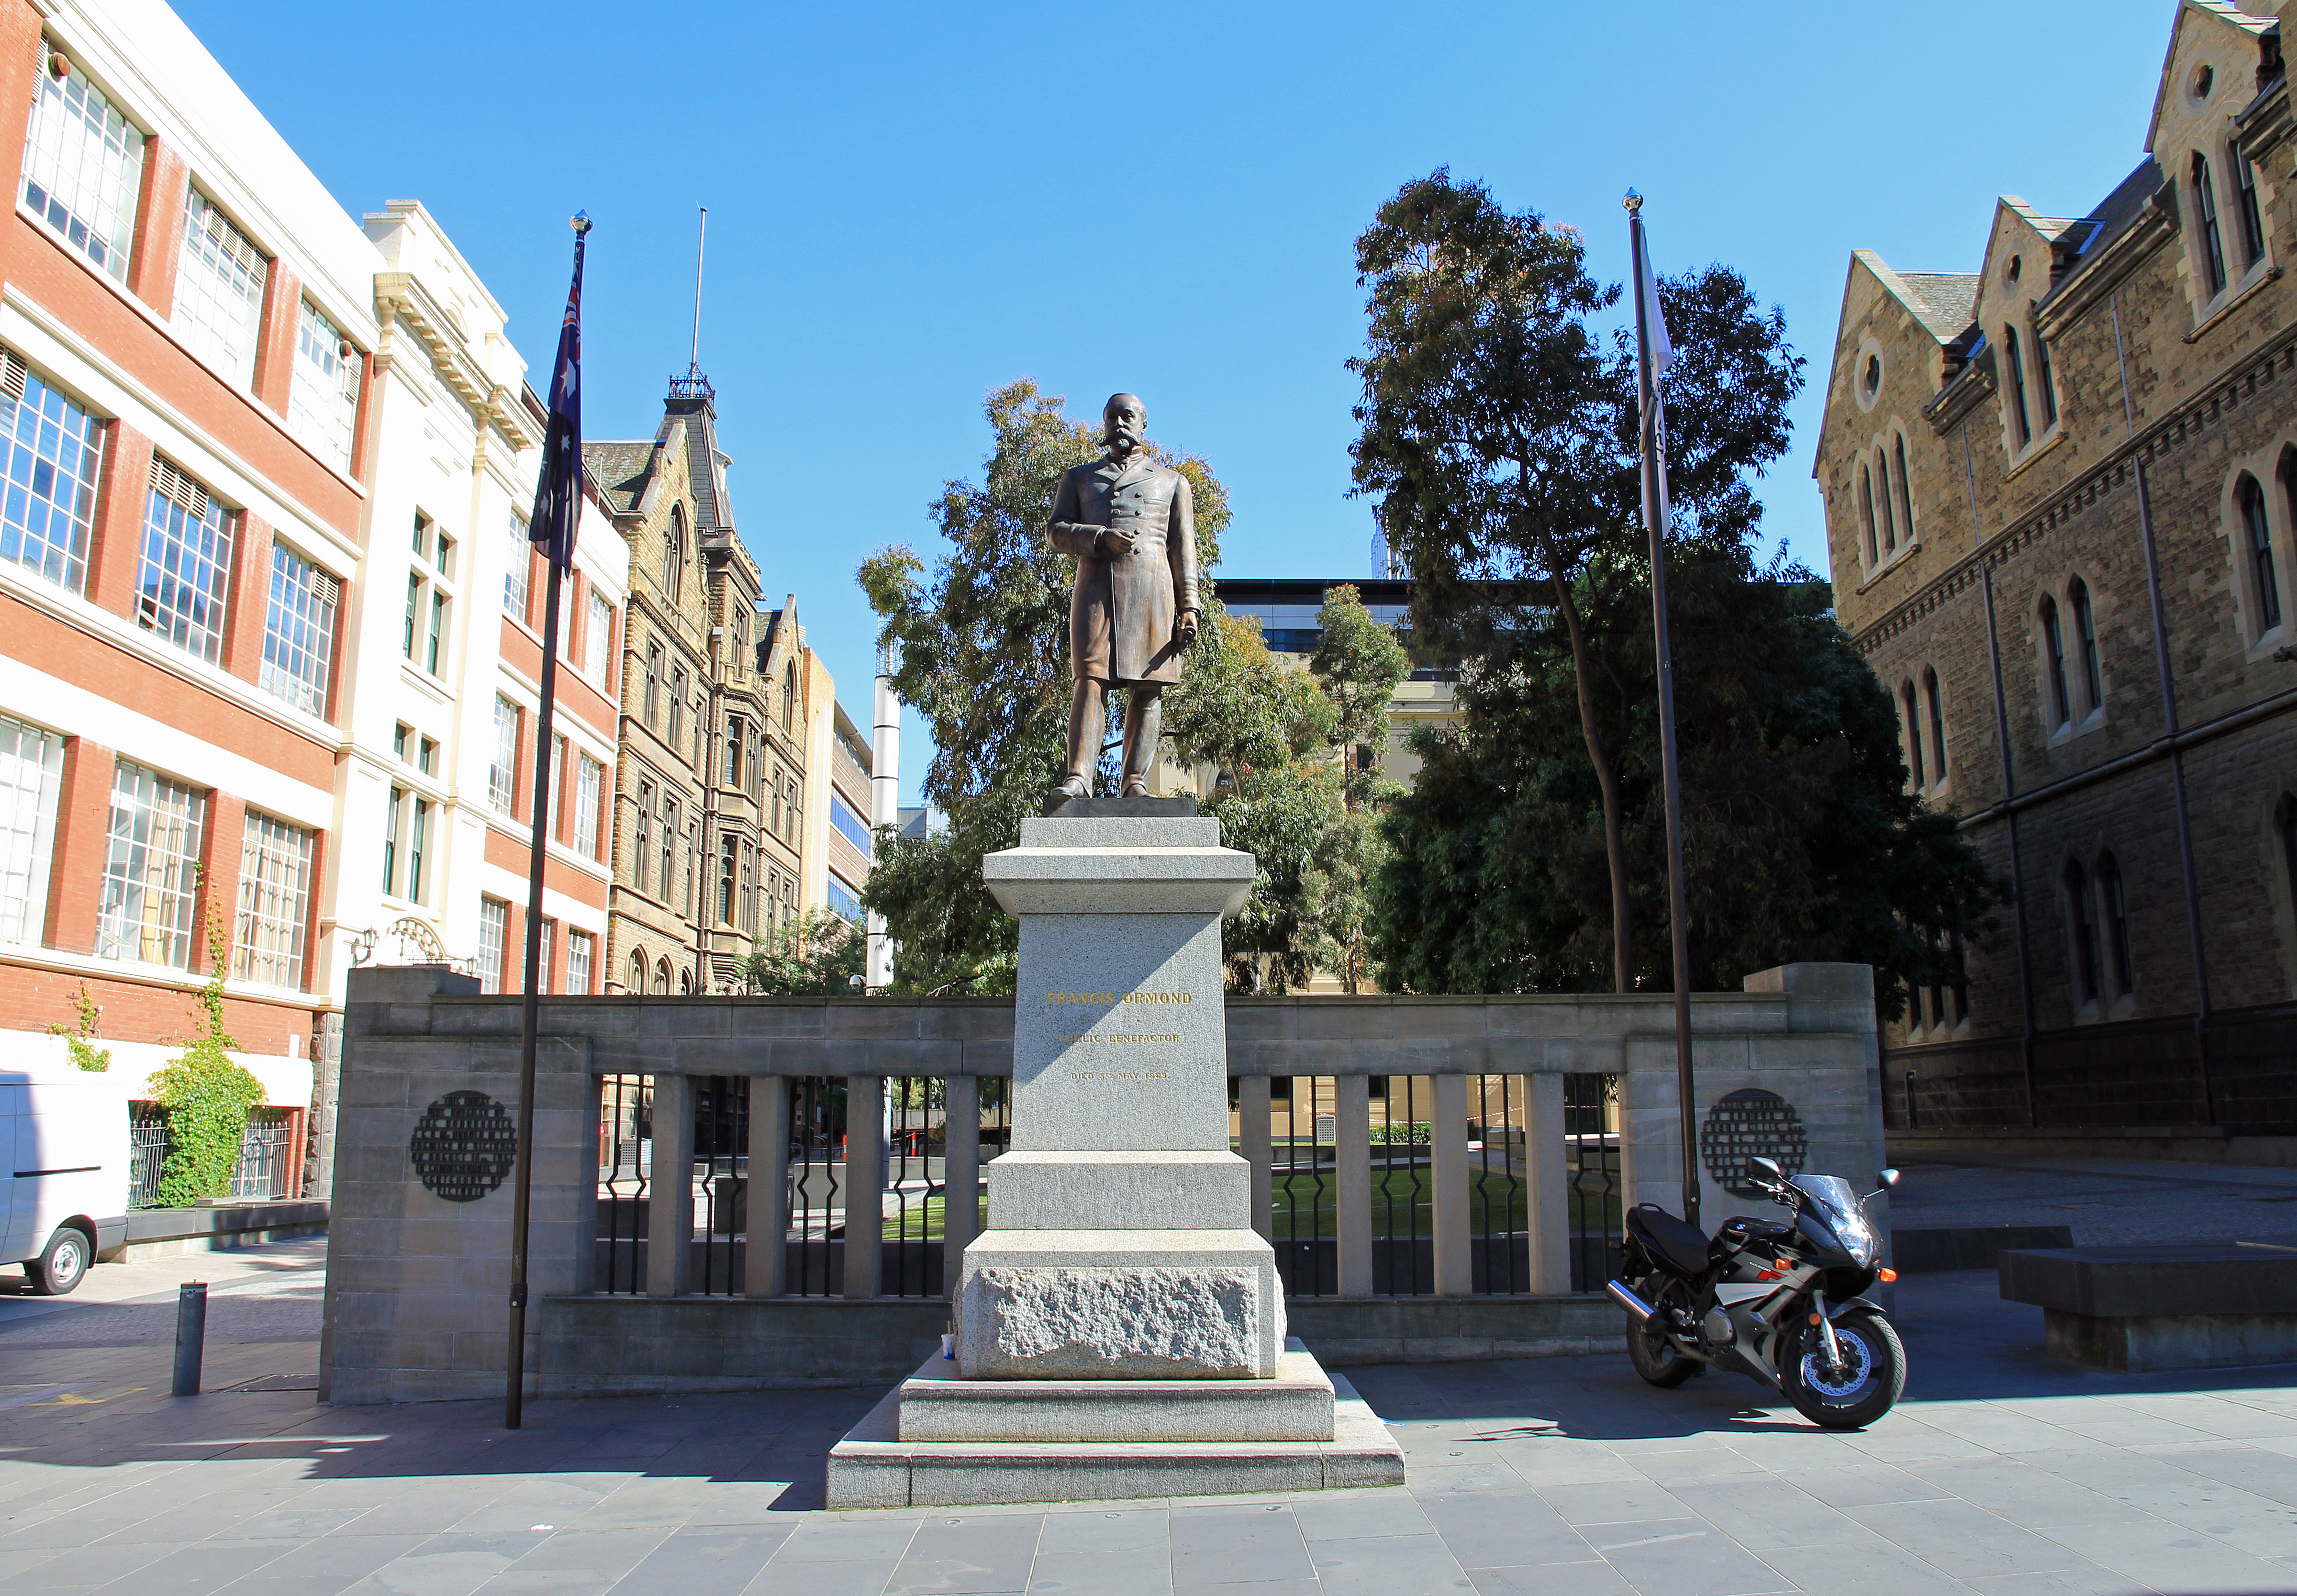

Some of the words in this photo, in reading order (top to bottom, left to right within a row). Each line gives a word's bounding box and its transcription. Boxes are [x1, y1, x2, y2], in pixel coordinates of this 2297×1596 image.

[1048, 993, 1115, 1004] FRANCIS
[1122, 993, 1192, 1004] ORMOND
[1059, 1035, 1101, 1043] PUBLIC
[1109, 1035, 1179, 1043] BENEFACTOR
